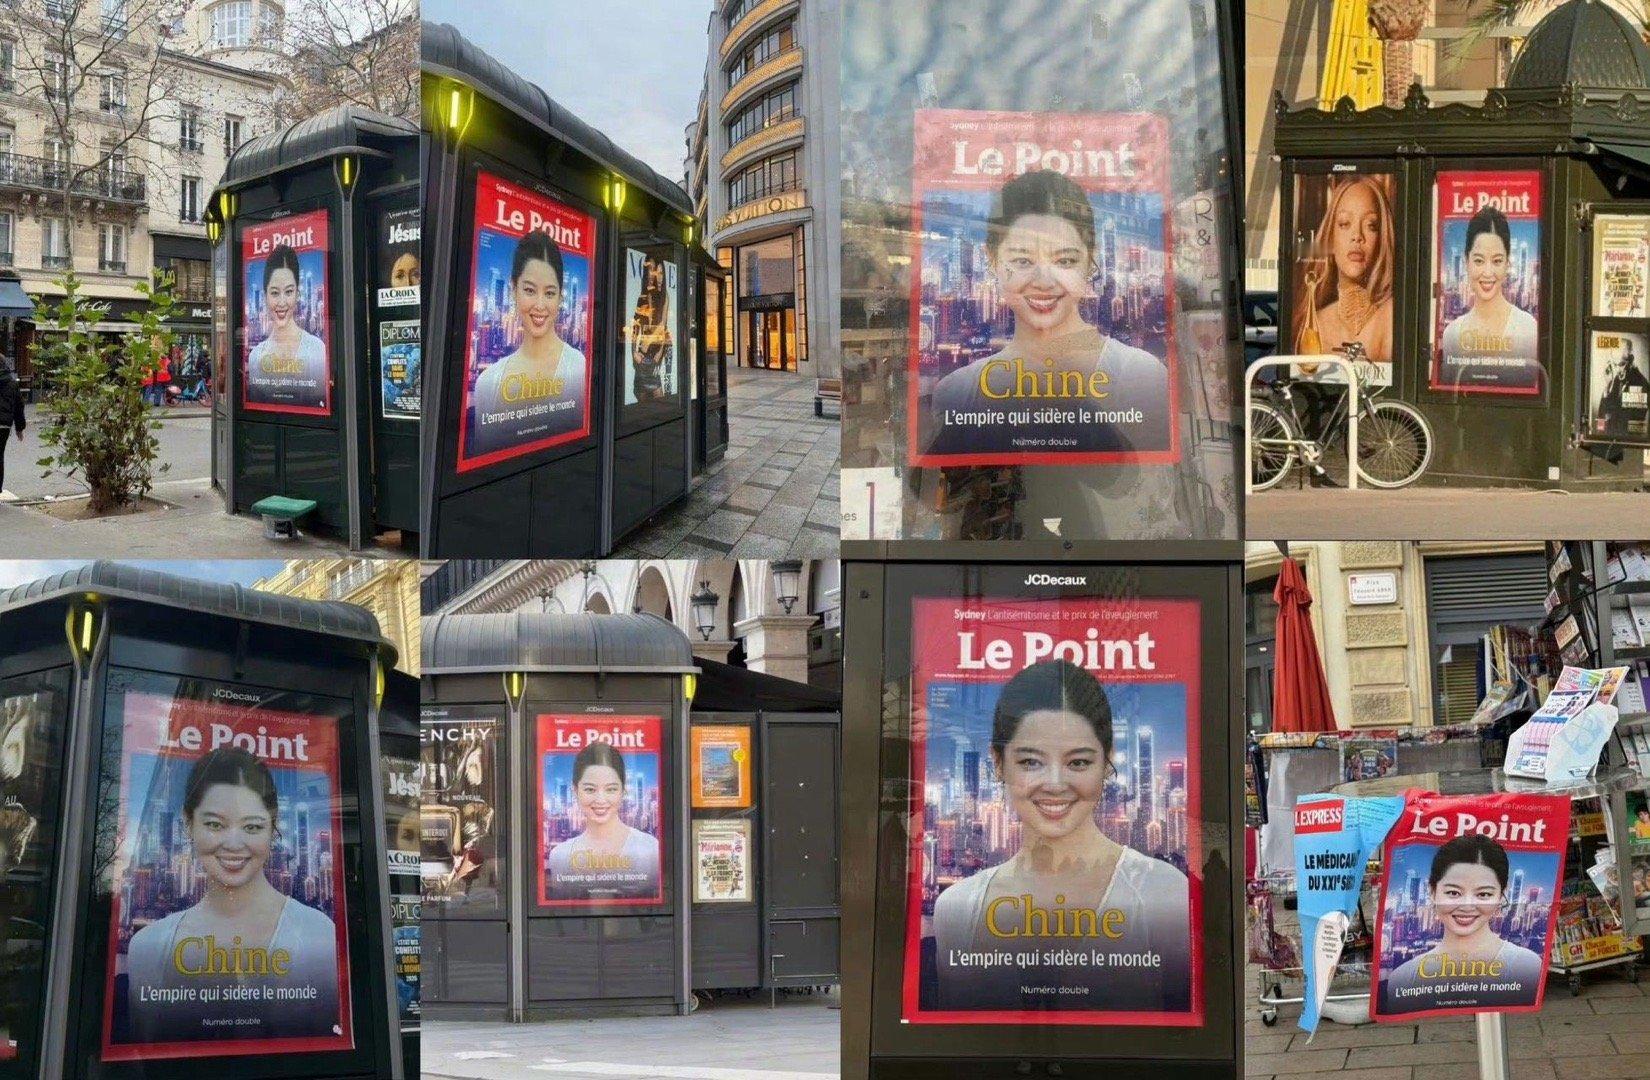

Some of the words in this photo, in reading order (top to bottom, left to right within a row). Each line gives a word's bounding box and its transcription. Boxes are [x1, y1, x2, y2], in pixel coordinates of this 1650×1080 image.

[952, 140, 1004, 175] Le
[1014, 139, 1135, 177] Point
[1453, 192, 1475, 213] Le
[1477, 189, 1530, 214] Point
[496, 199, 525, 230] Le
[529, 210, 580, 249] Point
[253, 237, 270, 254] Le
[273, 226, 314, 250] Point
[389, 288, 416, 298] CROIX
[501, 371, 564, 402] Chine
[979, 358, 1110, 398] Chine
[481, 407, 515, 425] L'empire
[516, 406, 528, 420] qui
[945, 408, 1004, 427] L'empire
[1008, 408, 1030, 426] qui
[1033, 407, 1075, 424] sidère
[1079, 407, 1090, 423] le
[1095, 407, 1143, 424] monde
[1012, 437, 1046, 447] Numéro
[1024, 574, 1087, 585] JCDecaux
[954, 609, 986, 620] Sydney
[987, 609, 1050, 620] L'antisémitisme
[1052, 611, 1060, 620] et
[1062, 610, 1069, 620] le
[1071, 610, 1087, 621] prix
[1089, 610, 1100, 619] de
[1101, 610, 1158, 621] l'aveuglement
[957, 632, 1013, 669] Le
[1023, 628, 1155, 670] Point
[213, 688, 261, 703] JCDecaux
[158, 718, 203, 750] Le
[210, 724, 309, 762] Point
[557, 729, 582, 747] Le
[585, 727, 645, 748] Point
[1295, 807, 1342, 827] L'EXPRESS
[1411, 810, 1449, 836] Le
[1454, 813, 1546, 843] Point
[570, 849, 632, 871] Chine
[1304, 854, 1316, 870] LE
[557, 873, 584, 883] L'empire
[585, 873, 596, 883] qui
[1308, 875, 1320, 891] DU
[985, 895, 1126, 940] Chine
[172, 935, 291, 977] Chine
[950, 951, 1013, 969] L'empire
[1016, 950, 1039, 969] qui
[1043, 951, 1088, 967] sidère
[1092, 951, 1104, 966] le
[1109, 951, 1161, 968] monde
[1417, 953, 1505, 980] Chine
[141, 985, 196, 1003] L'empire
[200, 985, 220, 1003] qui
[223, 985, 259, 1001] sidère
[263, 985, 273, 1000] le
[277, 984, 317, 1000] monde
[1020, 985, 1056, 995] Numéro
[1058, 985, 1090, 995] double
[1395, 985, 1433, 999] L'empire
[1434, 983, 1450, 995] qui
[1451, 982, 1479, 993] sidère
[1480, 981, 1490, 991] le
[1490, 981, 1522, 992] monde
[202, 1017, 233, 1027] Numéro
